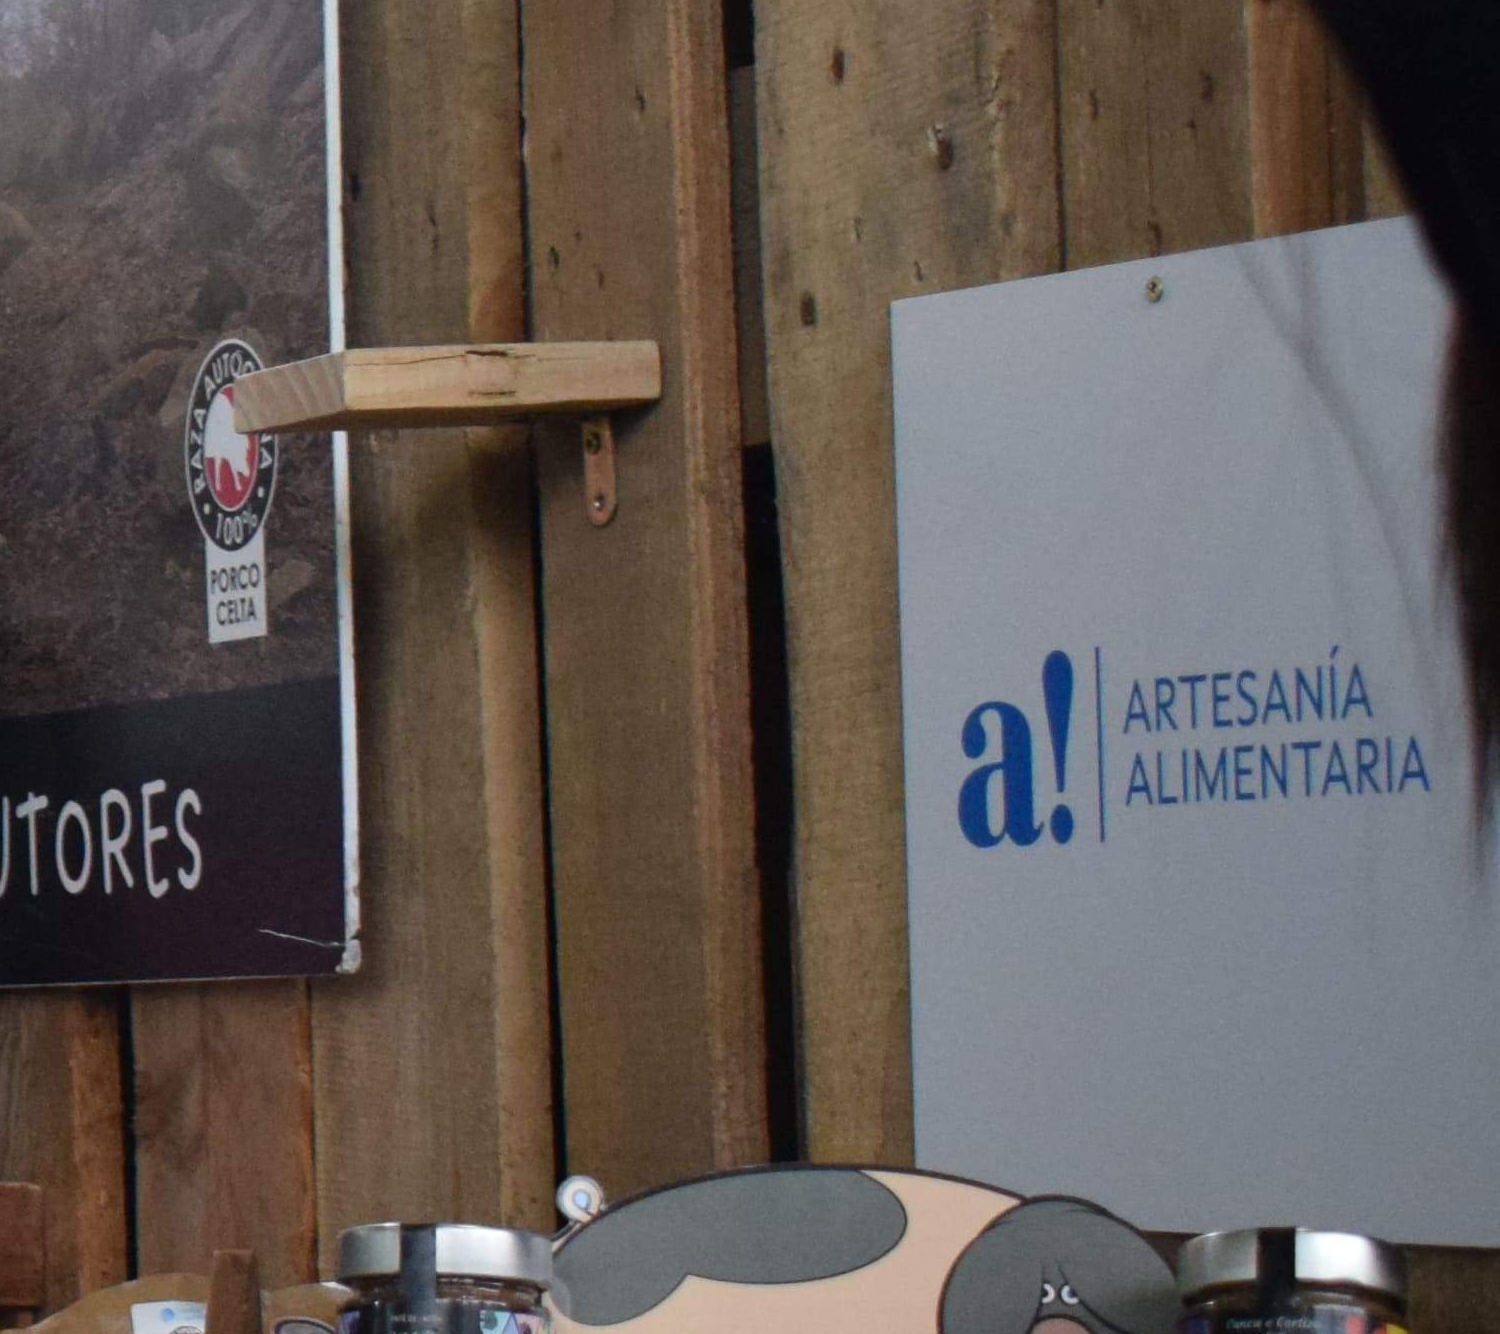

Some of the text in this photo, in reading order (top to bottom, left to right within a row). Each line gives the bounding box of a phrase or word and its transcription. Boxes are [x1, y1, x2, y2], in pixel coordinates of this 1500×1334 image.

[215, 510, 259, 546] 100%
[210, 562, 262, 595] PORCO
[216, 595, 259, 627] CELTA
[1122, 645, 1374, 735] ARTESANÍA
[1124, 735, 1431, 808] ALIMENTARIA
